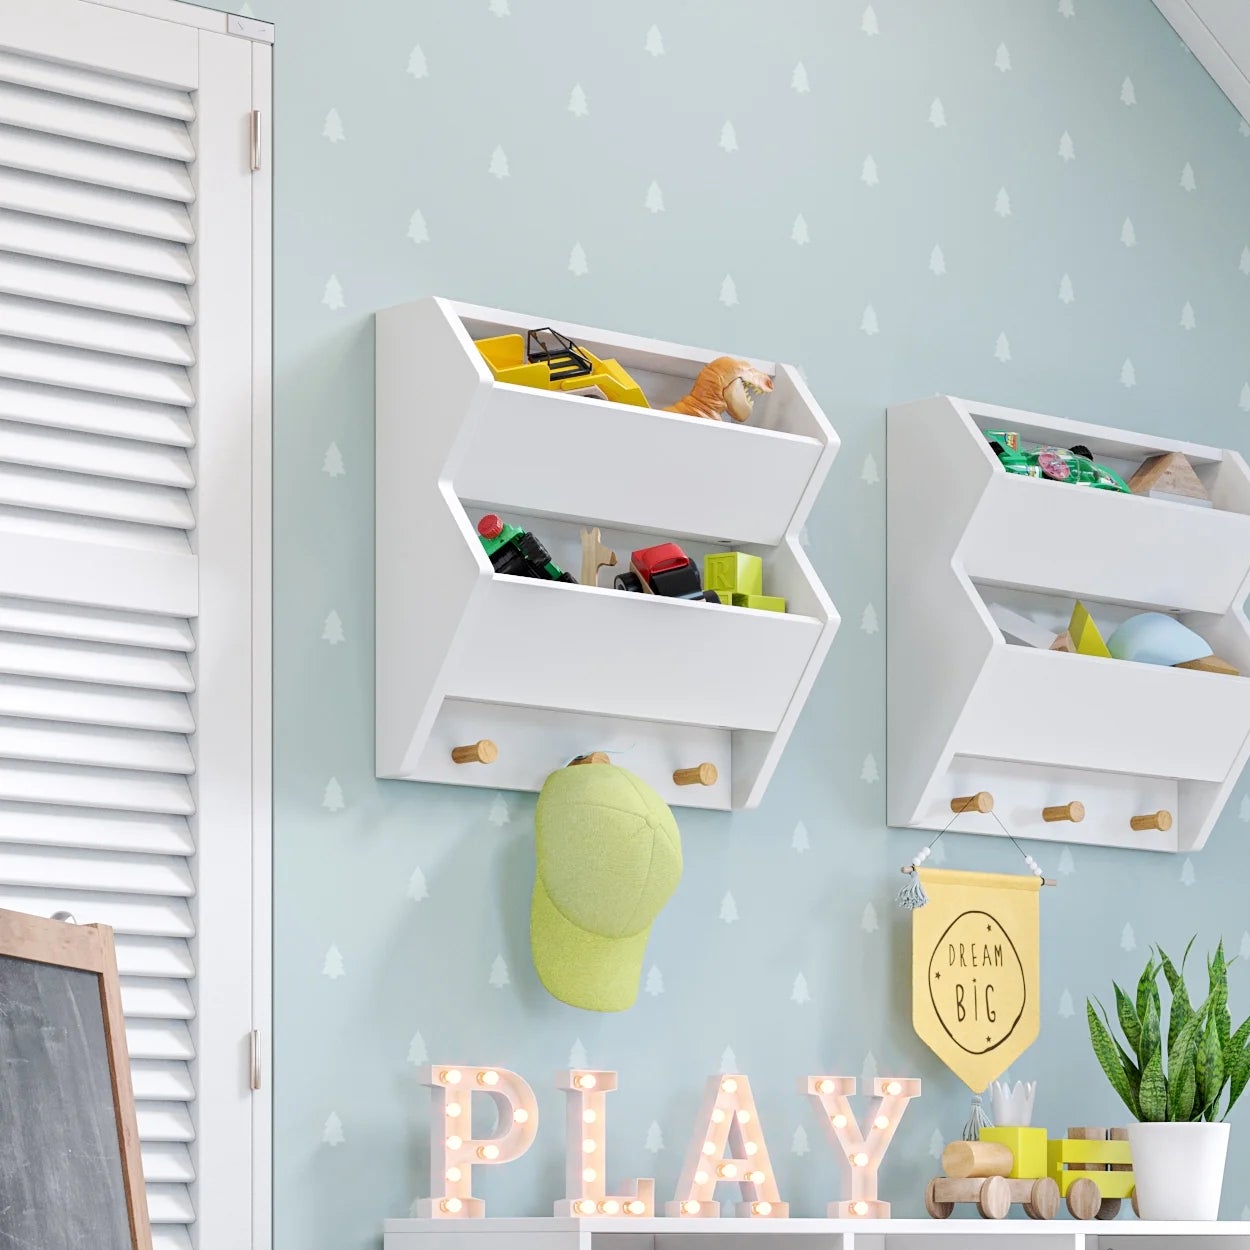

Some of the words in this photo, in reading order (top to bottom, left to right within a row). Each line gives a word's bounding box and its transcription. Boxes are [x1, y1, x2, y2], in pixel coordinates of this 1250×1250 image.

[711, 561, 735, 590] R
[949, 942, 1004, 968] DREAM
[420, 1064, 922, 1219] PLAY
